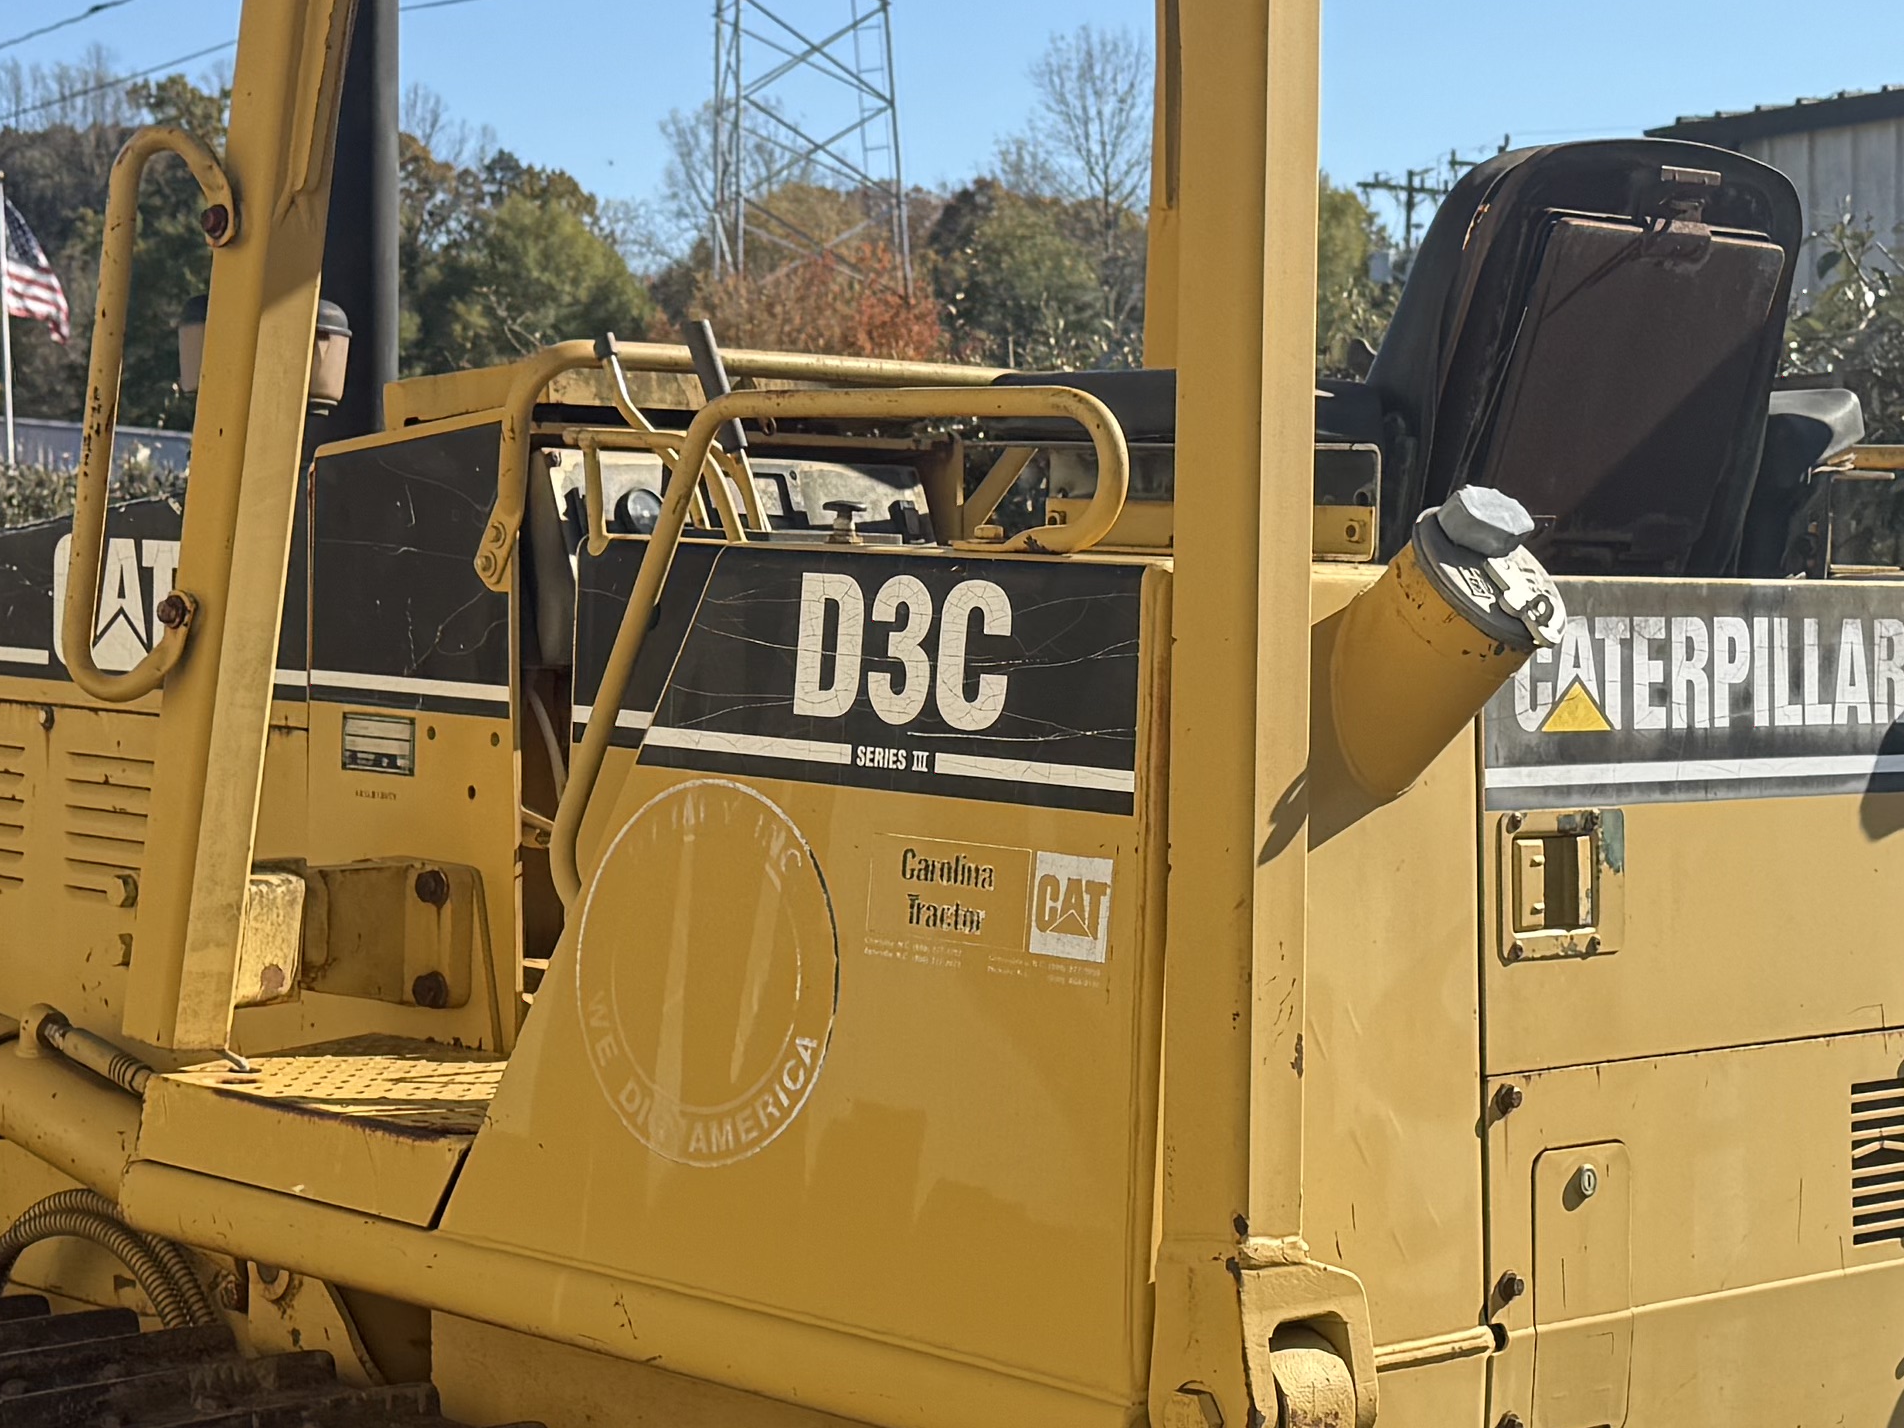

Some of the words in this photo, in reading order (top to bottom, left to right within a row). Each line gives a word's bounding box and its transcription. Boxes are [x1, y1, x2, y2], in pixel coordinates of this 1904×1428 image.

[793, 572, 1012, 731] D3C
[856, 745, 907, 770] SERIES
[912, 750, 929, 772] III
[901, 847, 995, 892] Carolina
[907, 893, 985, 935] Tractor
[1035, 873, 1110, 941] CAT
[688, 1036, 818, 1154] AMERICA
